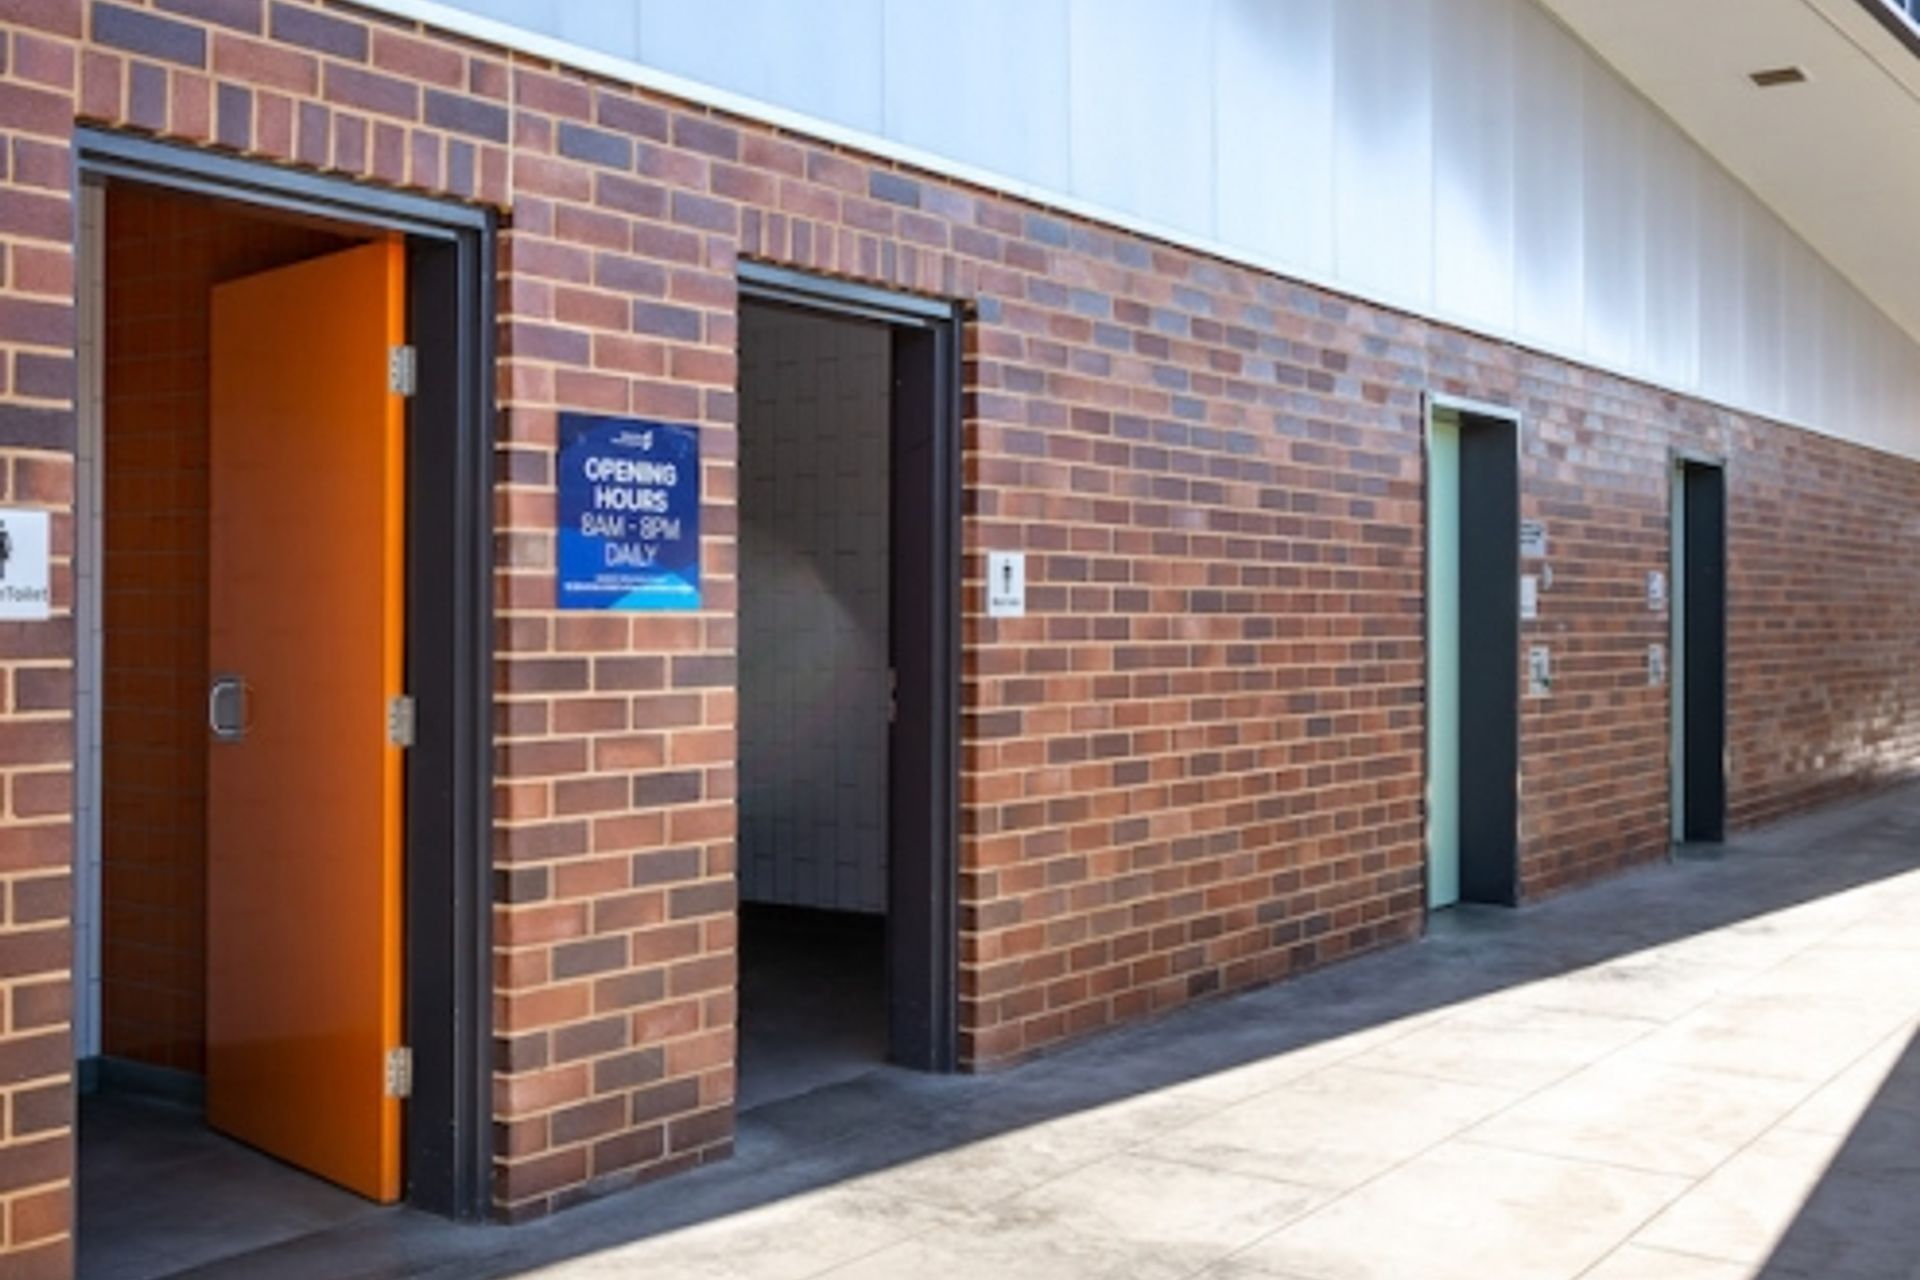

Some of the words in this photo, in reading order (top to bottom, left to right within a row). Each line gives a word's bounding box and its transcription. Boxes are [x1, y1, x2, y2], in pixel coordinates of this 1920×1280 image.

[585, 457, 677, 486] OPENING
[593, 486, 669, 513] HOURS
[581, 512, 625, 537] 8AM
[640, 516, 680, 540] 8PM
[605, 543, 658, 567] DAILY
